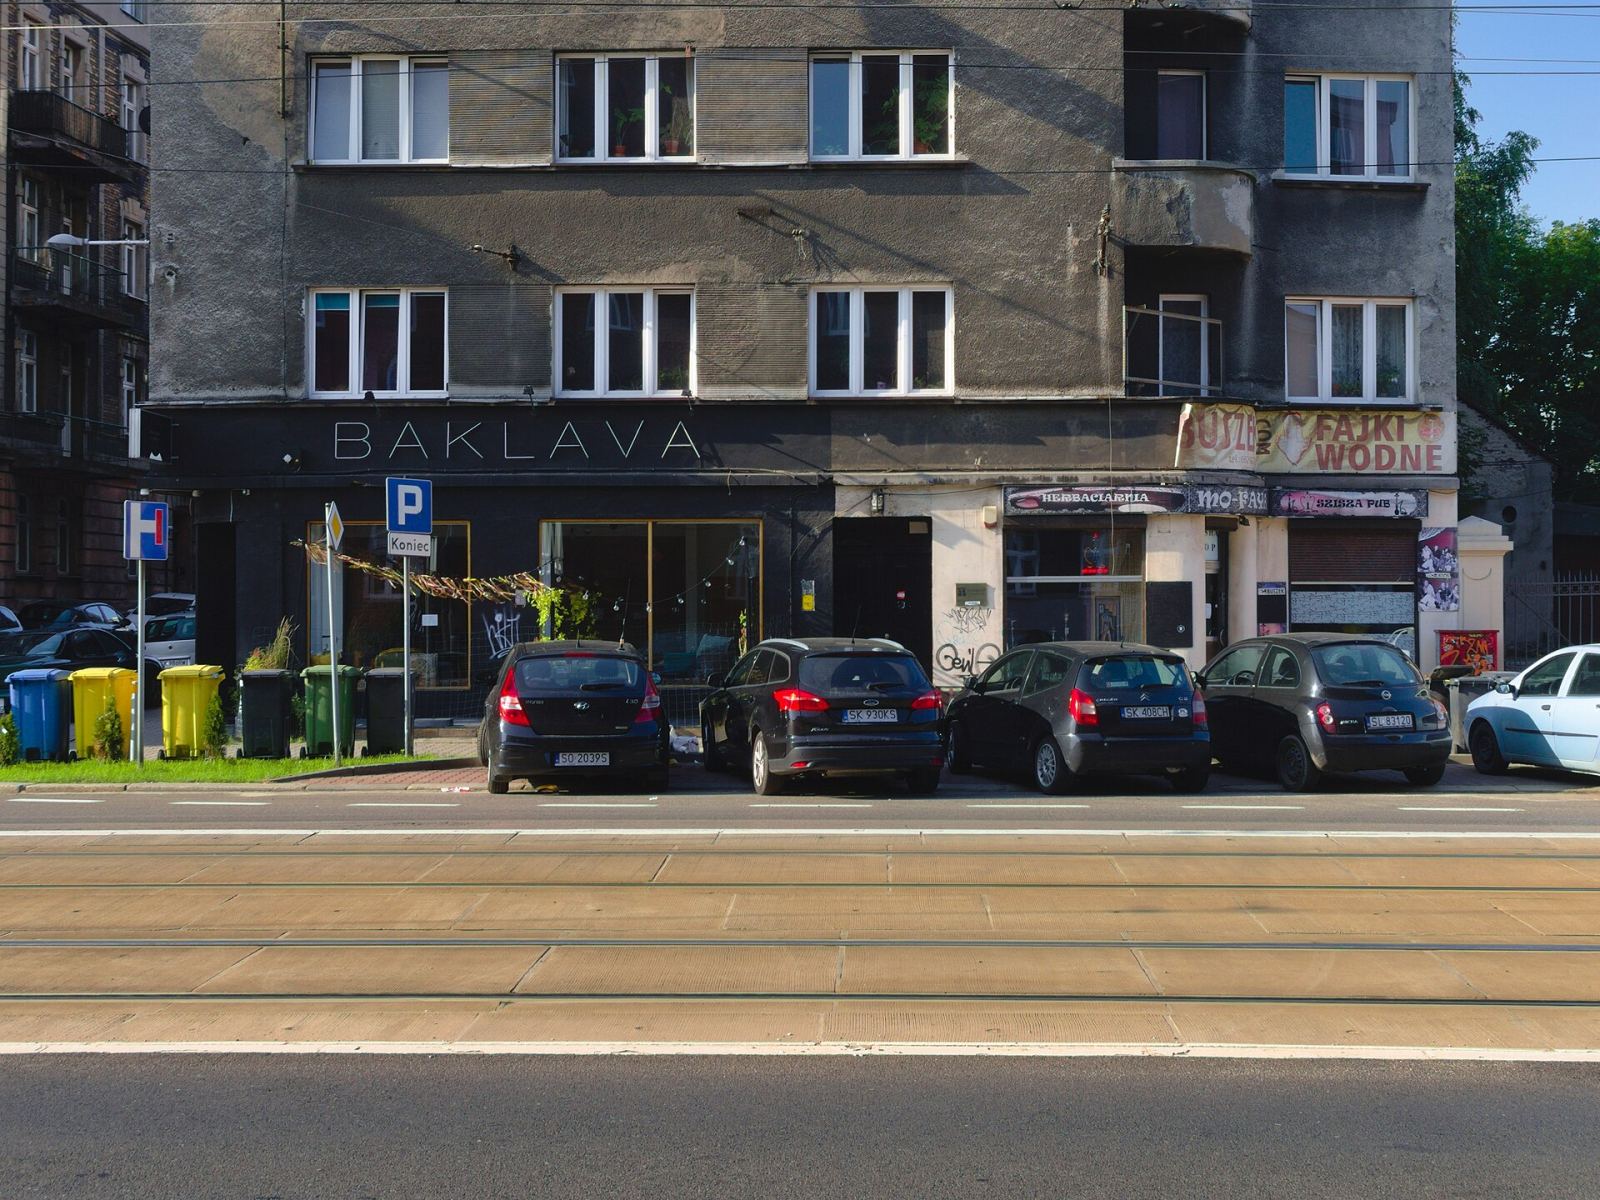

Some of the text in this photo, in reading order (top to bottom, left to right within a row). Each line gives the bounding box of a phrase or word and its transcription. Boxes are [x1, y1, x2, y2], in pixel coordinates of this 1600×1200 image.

[1315, 414, 1404, 442] FAJKI
[334, 419, 701, 460] BAKLAVA
[1314, 443, 1442, 472] WODNE
[1041, 492, 1149, 503] HERBACIARNIA
[397, 484, 423, 526] P
[1316, 499, 1391, 509] SZISZA PUB
[391, 537, 429, 552] Koniec
[849, 709, 896, 720] SK 930KS
[1126, 707, 1139, 718] SK
[1141, 706, 1169, 717] 408CH
[1371, 716, 1411, 727] SL 83120
[561, 753, 574, 763] SO
